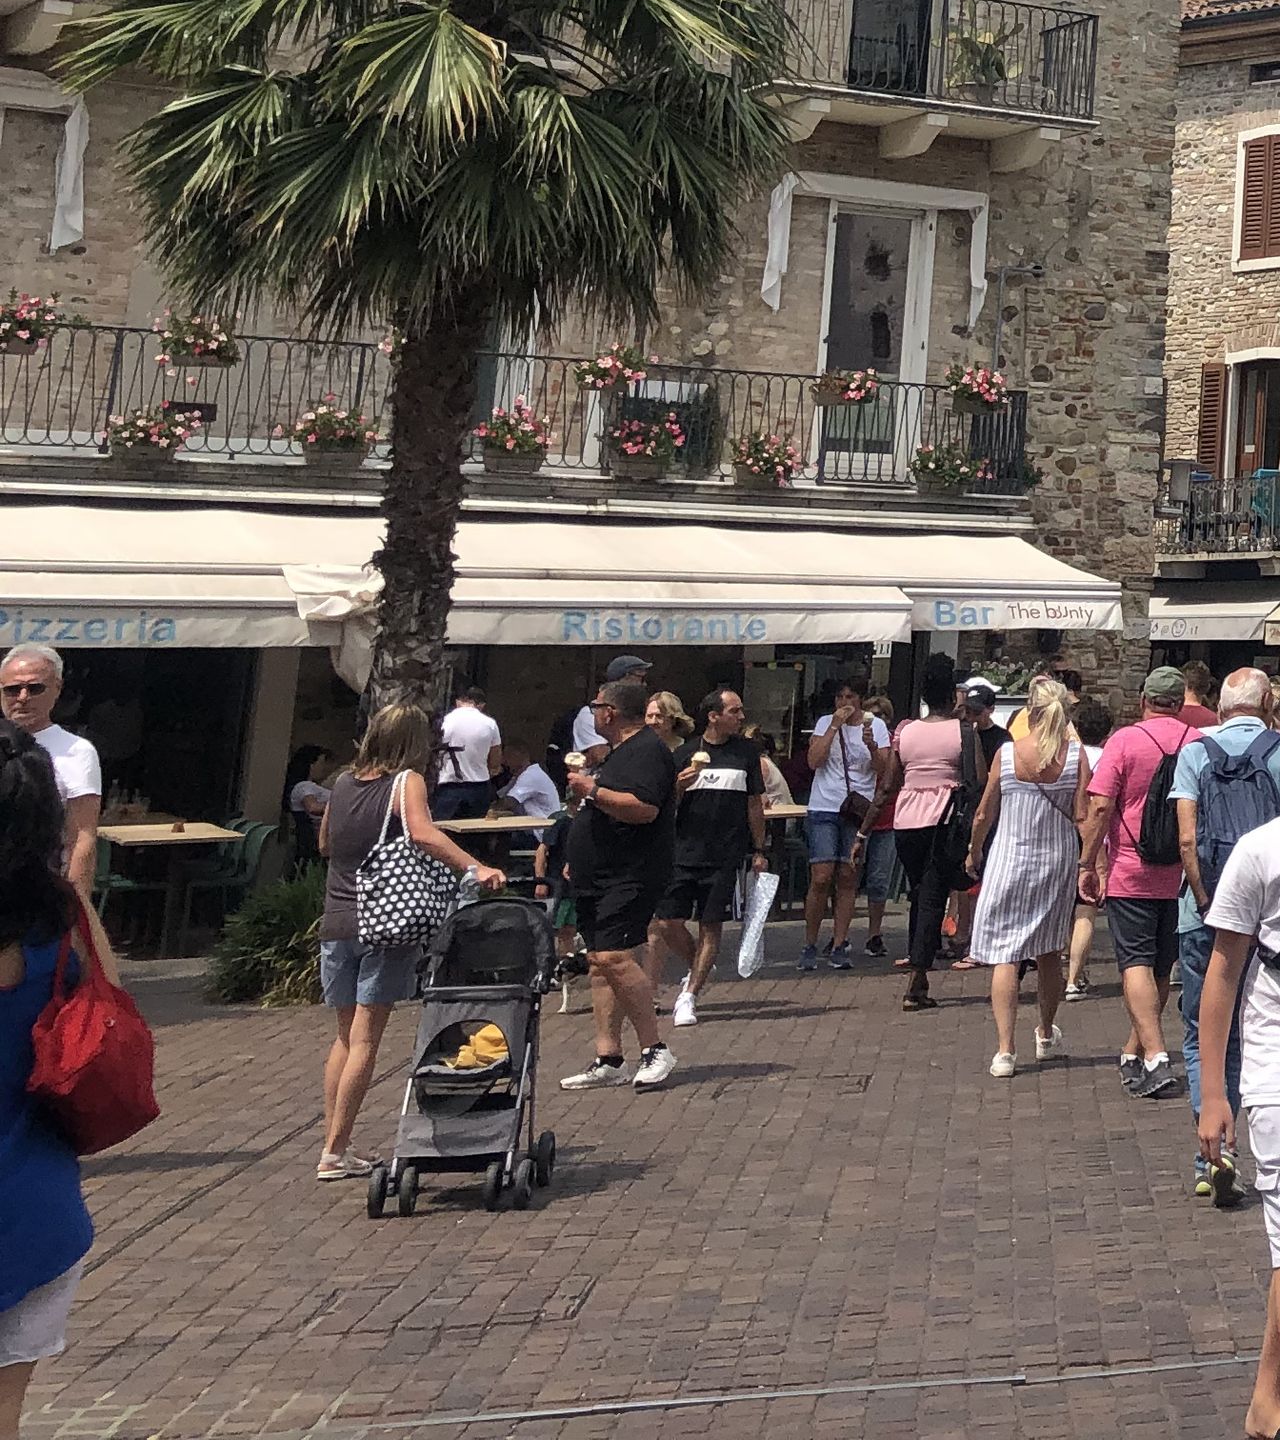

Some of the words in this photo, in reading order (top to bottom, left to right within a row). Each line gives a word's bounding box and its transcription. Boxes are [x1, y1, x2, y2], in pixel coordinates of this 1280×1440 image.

[934, 599, 995, 627] Bar
[1008, 602, 1041, 620] The
[562, 611, 767, 641] Ristorante
